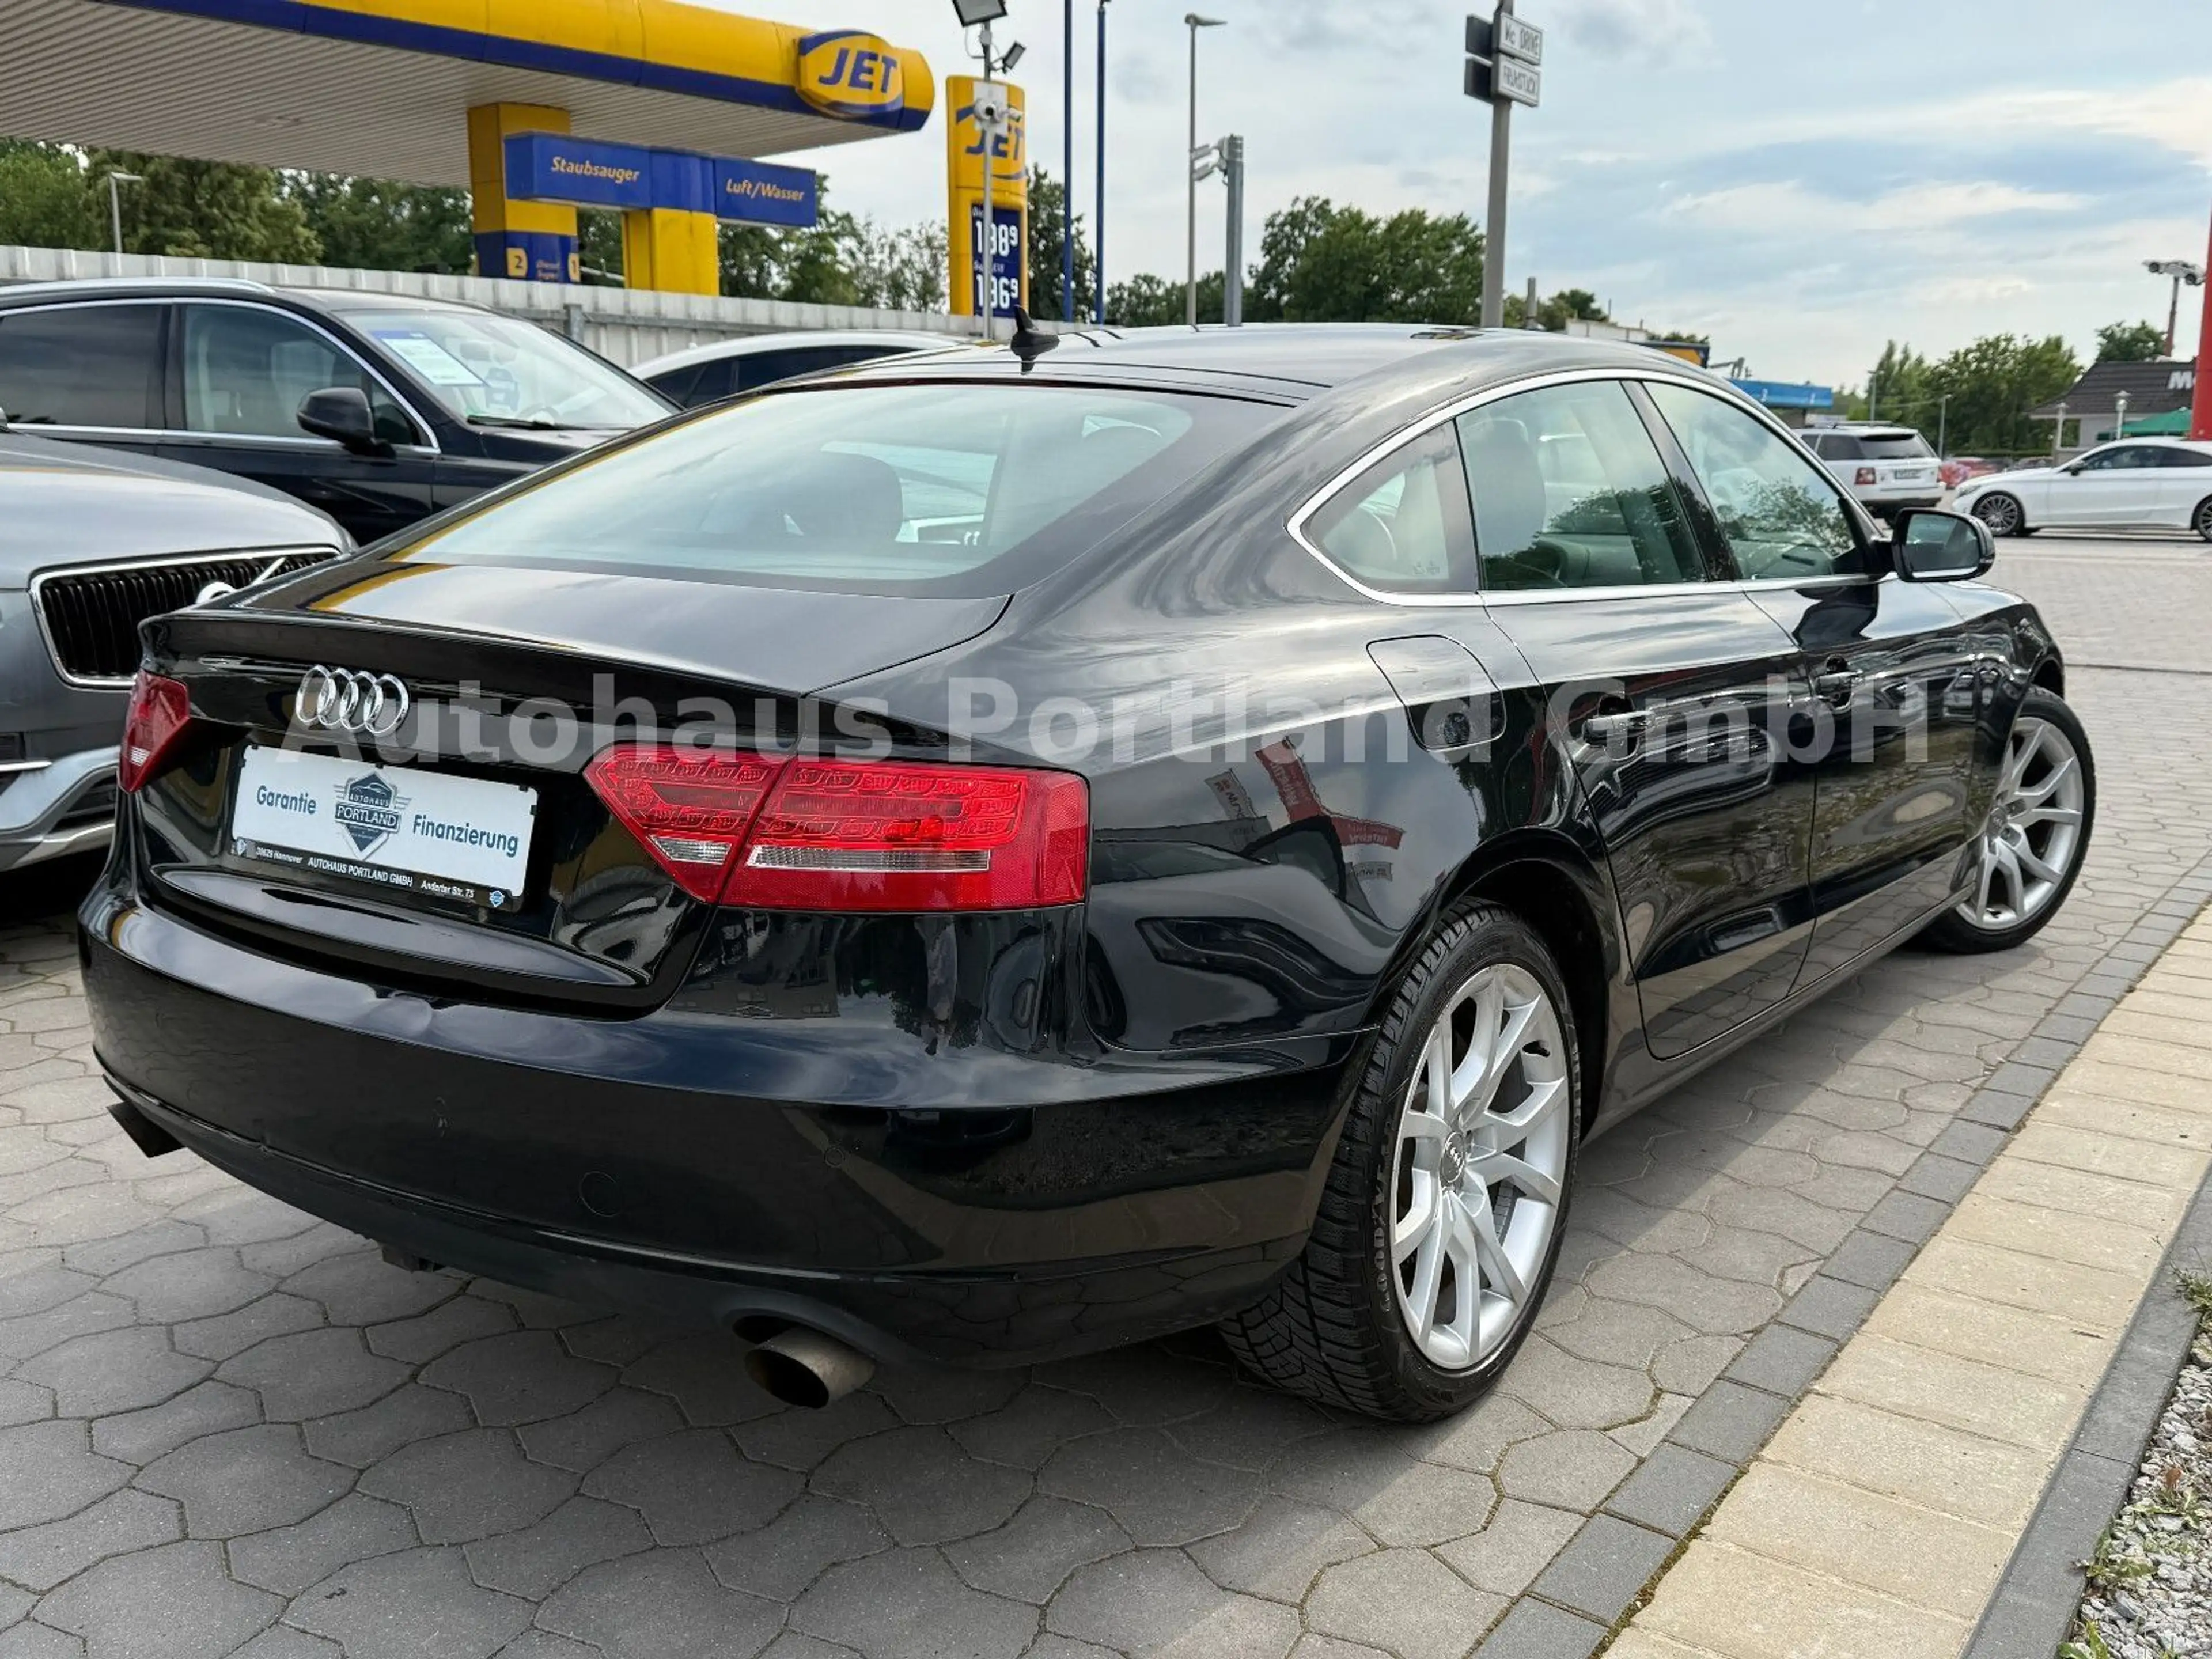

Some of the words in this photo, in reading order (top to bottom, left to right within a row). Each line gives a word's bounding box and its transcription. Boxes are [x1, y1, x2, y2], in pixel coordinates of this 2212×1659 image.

[819, 47, 897, 93] JET
[550, 156, 640, 184] Staubsauger
[726, 177, 805, 200] Luft/Wasser
[513, 255, 523, 269] 2
[257, 785, 316, 815] Garantie
[349, 793, 389, 807] AUTOHAUS
[336, 805, 397, 827] PORTLAND
[413, 814, 518, 858] Finanzierung
[308, 857, 347, 873] AUTOHAUS
[348, 865, 388, 882] PORTLAND
[389, 873, 413, 887] GMBH
